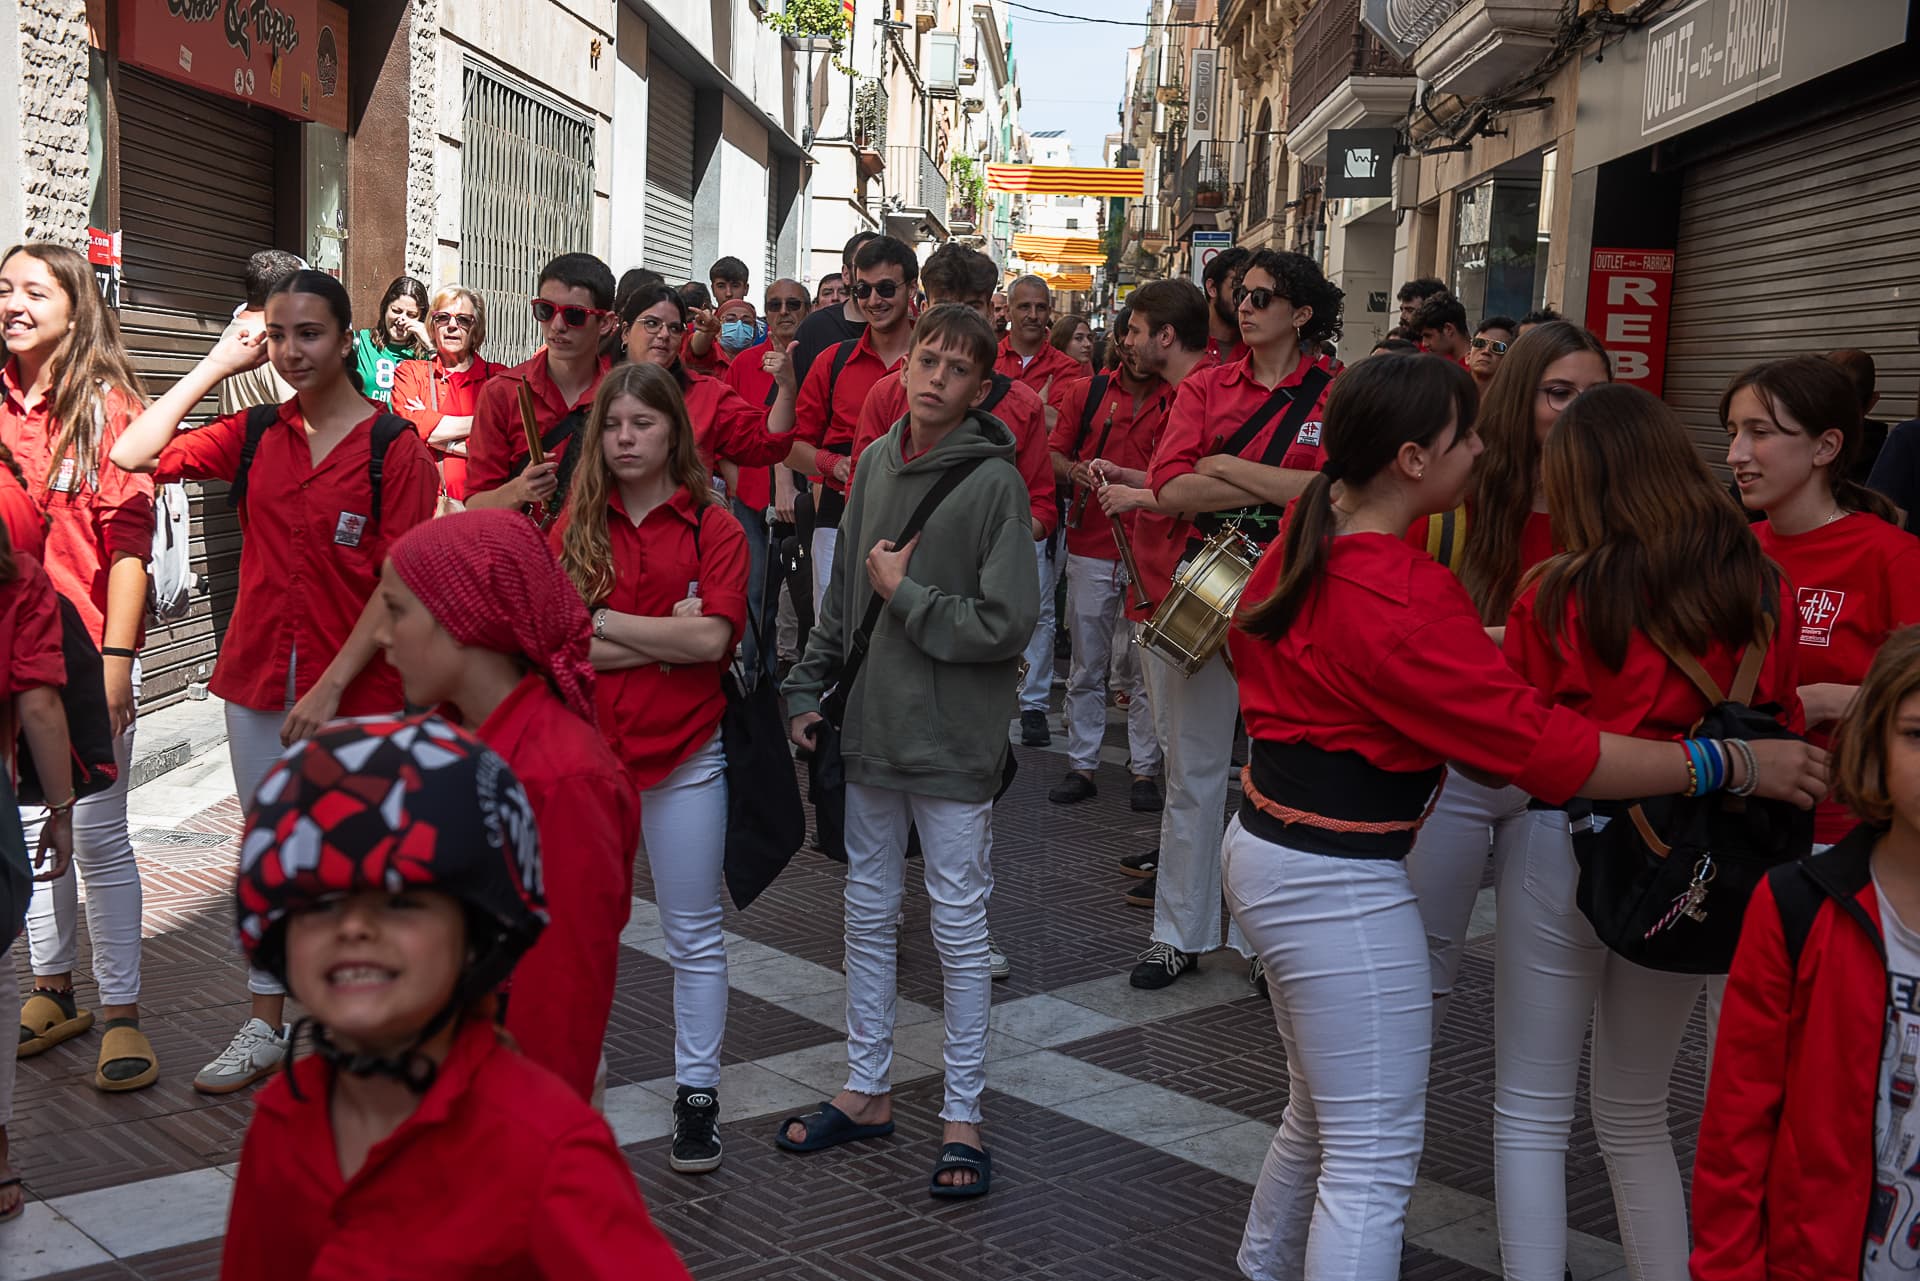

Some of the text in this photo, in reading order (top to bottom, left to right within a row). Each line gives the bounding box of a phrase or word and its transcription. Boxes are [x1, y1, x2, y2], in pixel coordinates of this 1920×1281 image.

[1646, 20, 1695, 121] OUTLET
[1722, 0, 1782, 86] FABRICA
[1195, 61, 1210, 123] SEIKO
[1596, 254, 1624, 269] OUTLET
[1642, 255, 1671, 271] FABRICA
[375, 358, 395, 390] 8
